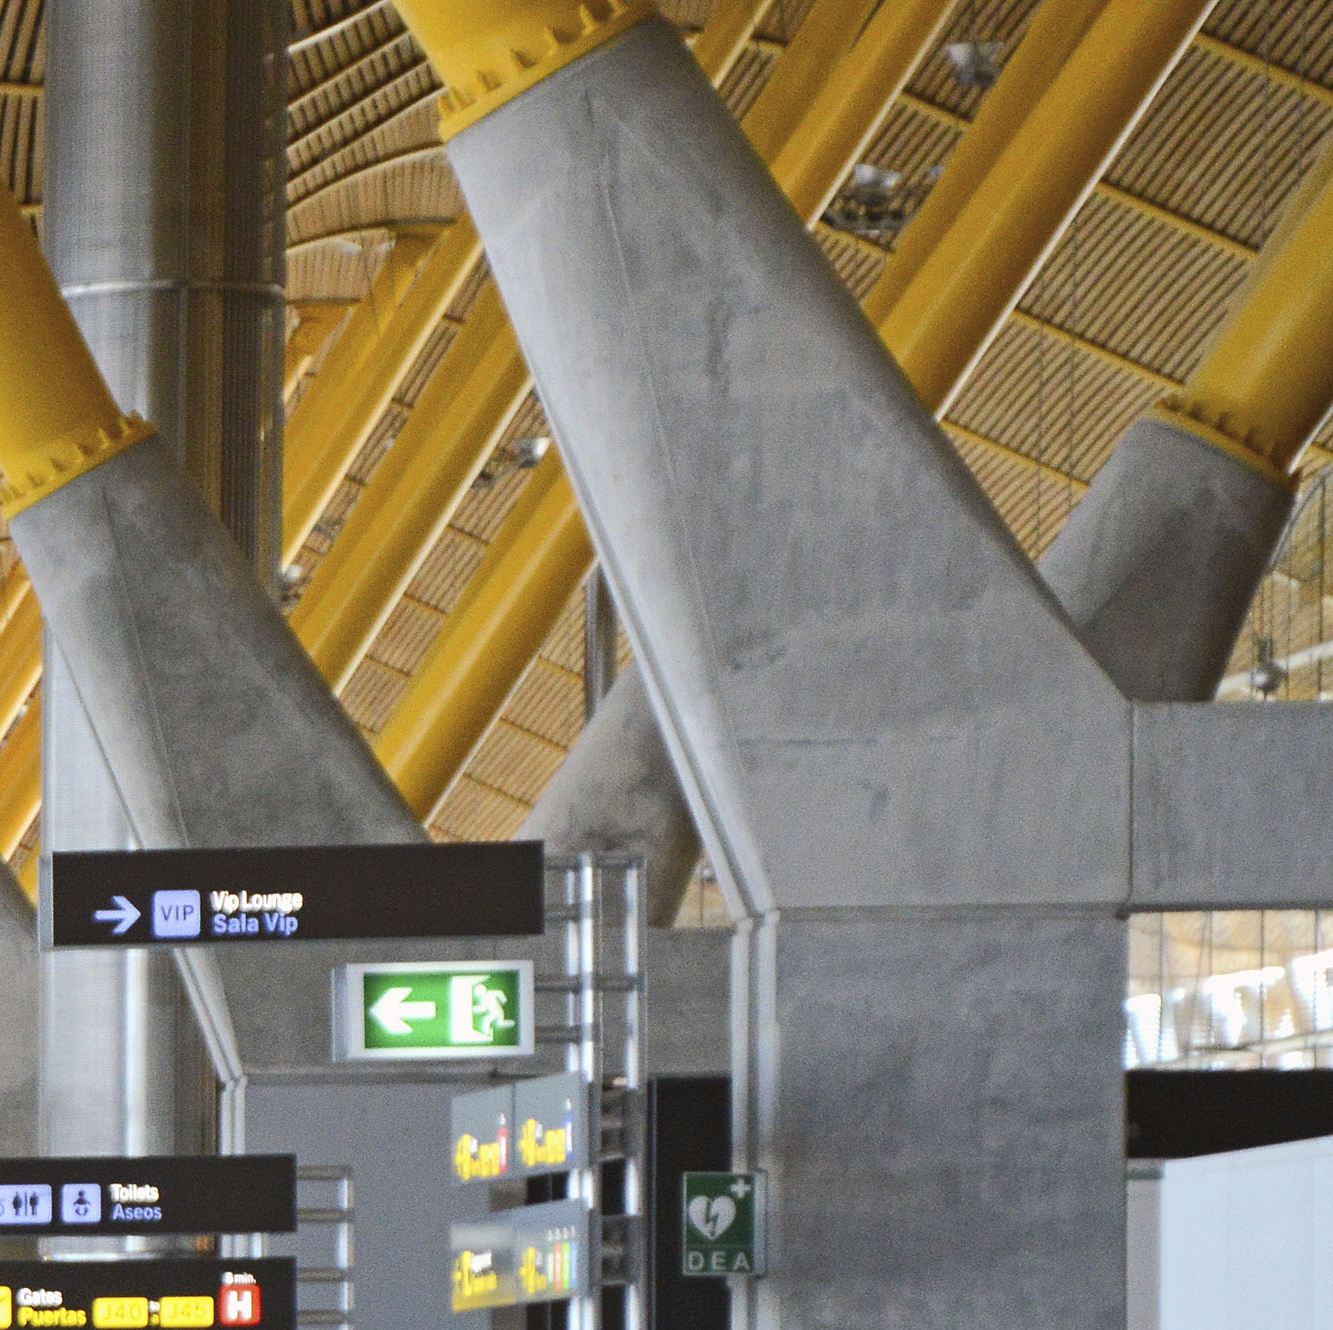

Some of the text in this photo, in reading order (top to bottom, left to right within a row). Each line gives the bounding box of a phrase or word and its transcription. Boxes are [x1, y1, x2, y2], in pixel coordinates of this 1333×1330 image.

[161, 890, 304, 921] VIP Vip Lounge
[213, 912, 299, 937] Sala Vip
[109, 1183, 159, 1202] Toilets
[111, 1203, 162, 1220] Aseos
[689, 1251, 751, 1272] DEA
[17, 1287, 63, 1306] Gates
[227, 1291, 253, 1320] H
[18, 1306, 87, 1327] Puertas
